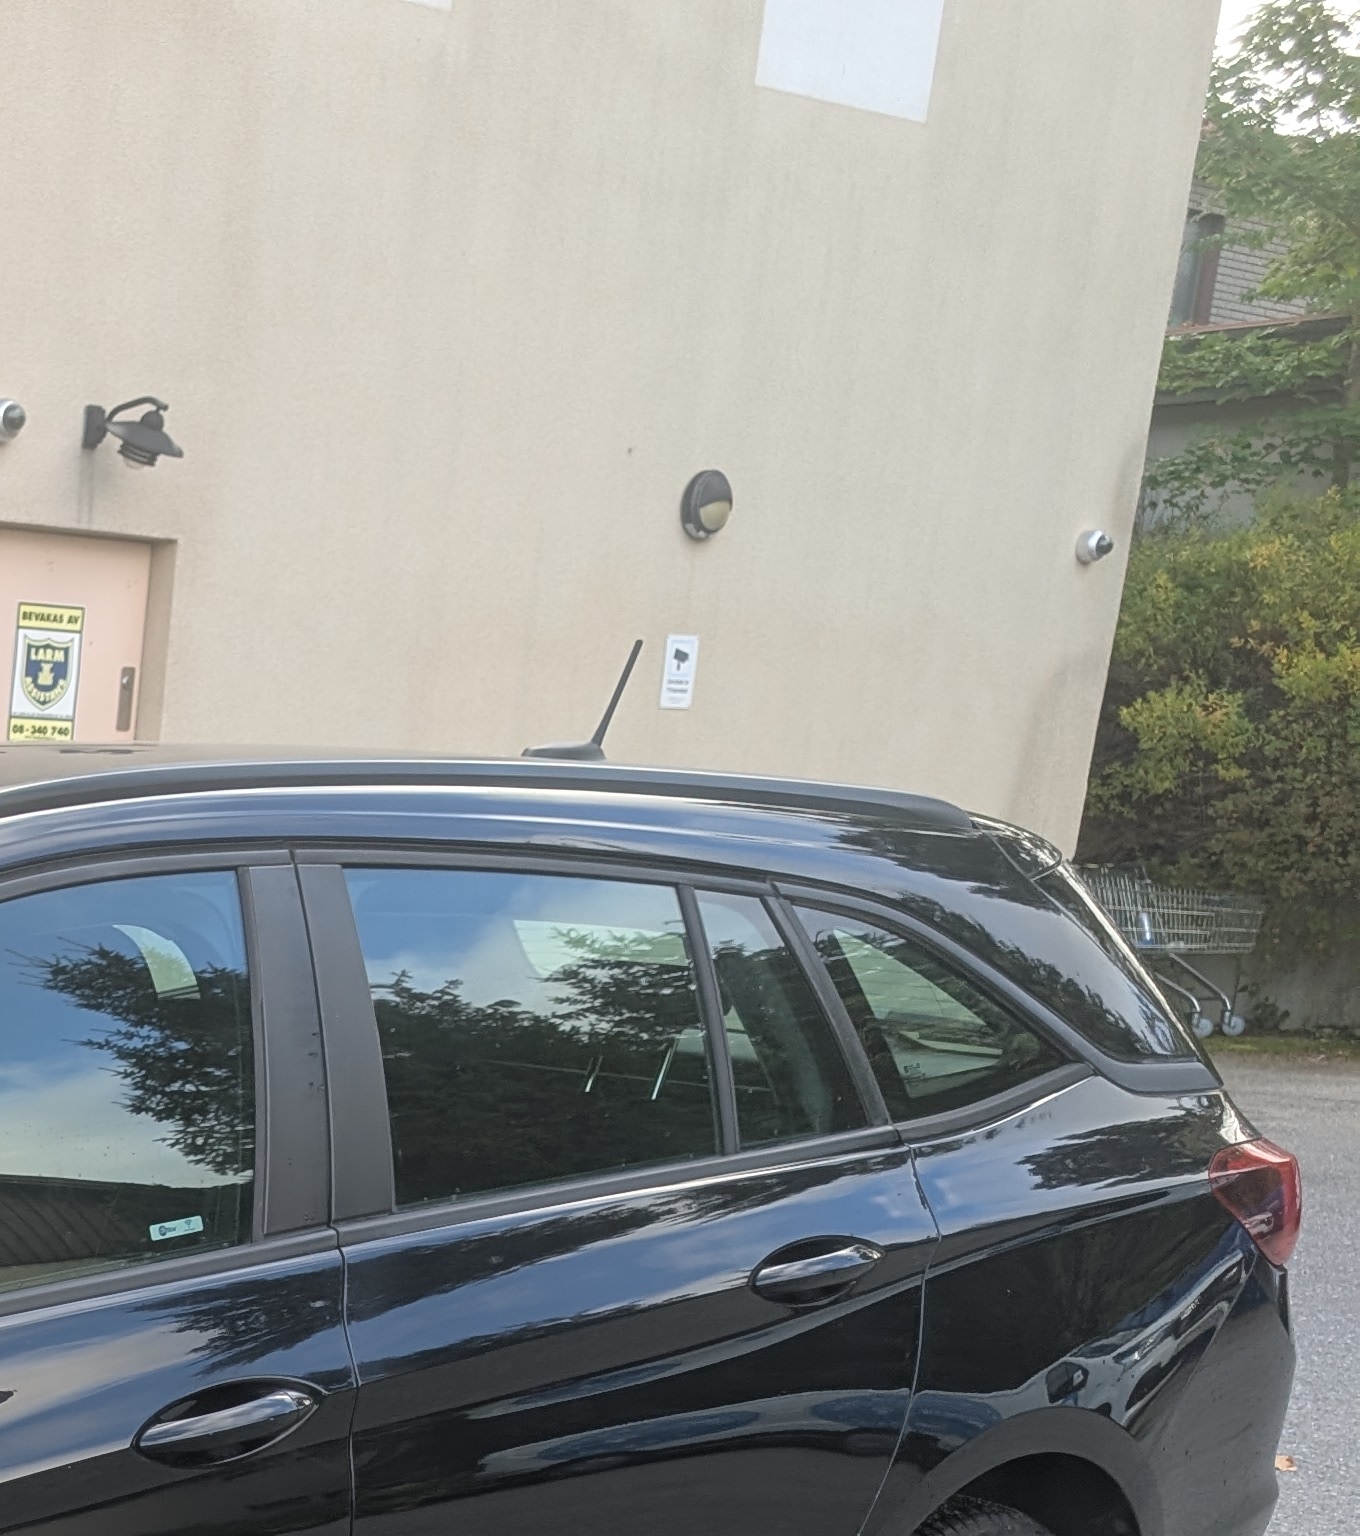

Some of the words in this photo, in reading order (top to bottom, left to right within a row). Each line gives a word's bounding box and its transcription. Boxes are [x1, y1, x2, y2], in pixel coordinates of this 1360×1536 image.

[22, 611, 64, 623] BEVAKAS
[67, 615, 80, 624] AV
[30, 647, 65, 662] LARM
[51, 726, 70, 737] 740
